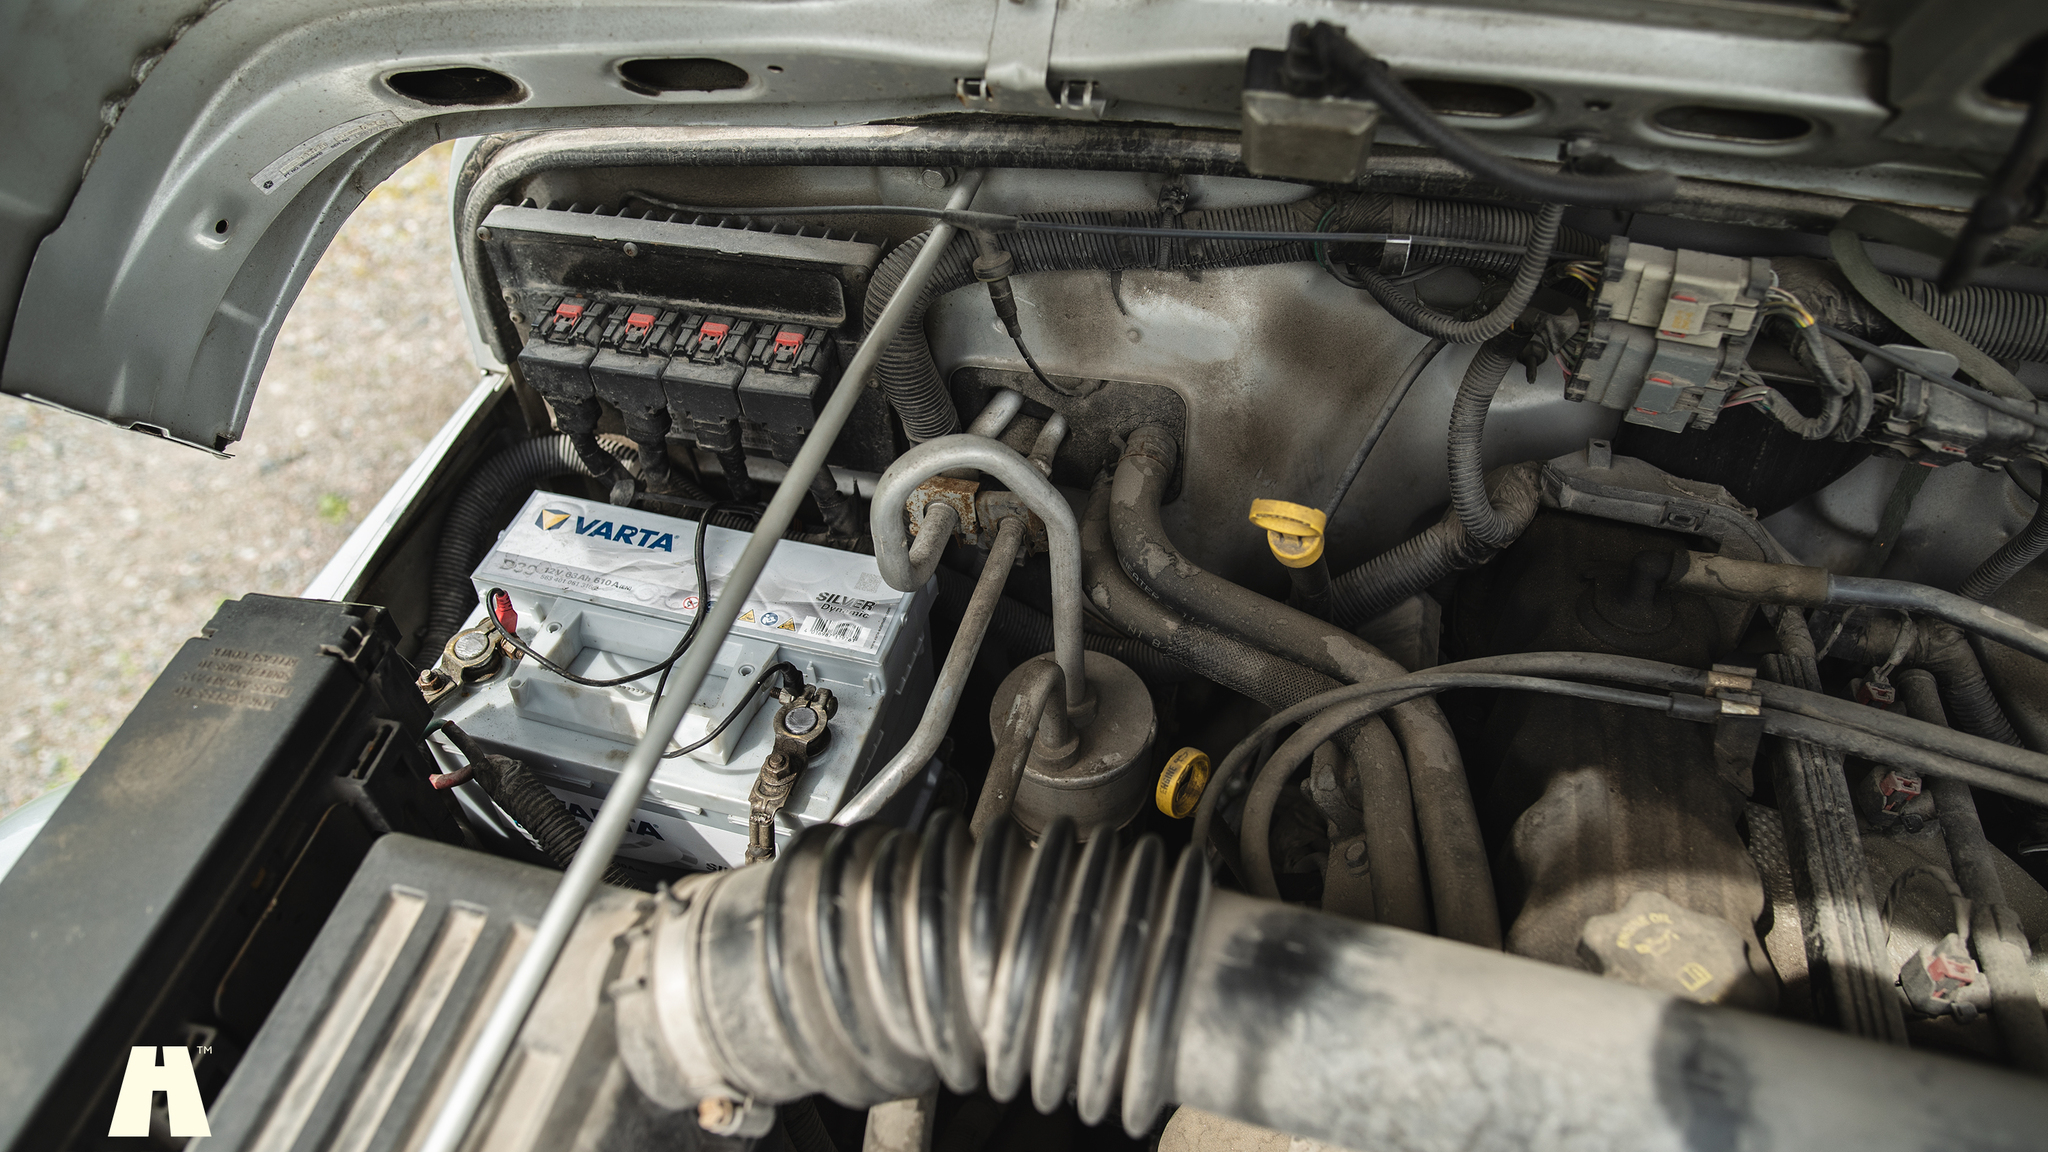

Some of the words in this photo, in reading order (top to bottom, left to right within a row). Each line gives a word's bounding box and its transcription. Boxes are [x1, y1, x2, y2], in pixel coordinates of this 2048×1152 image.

[575, 515, 674, 553] VARTA
[1122, 556, 1161, 600] HEATER
[816, 592, 876, 611] SILVER
[1160, 765, 1177, 795] ENGINE
